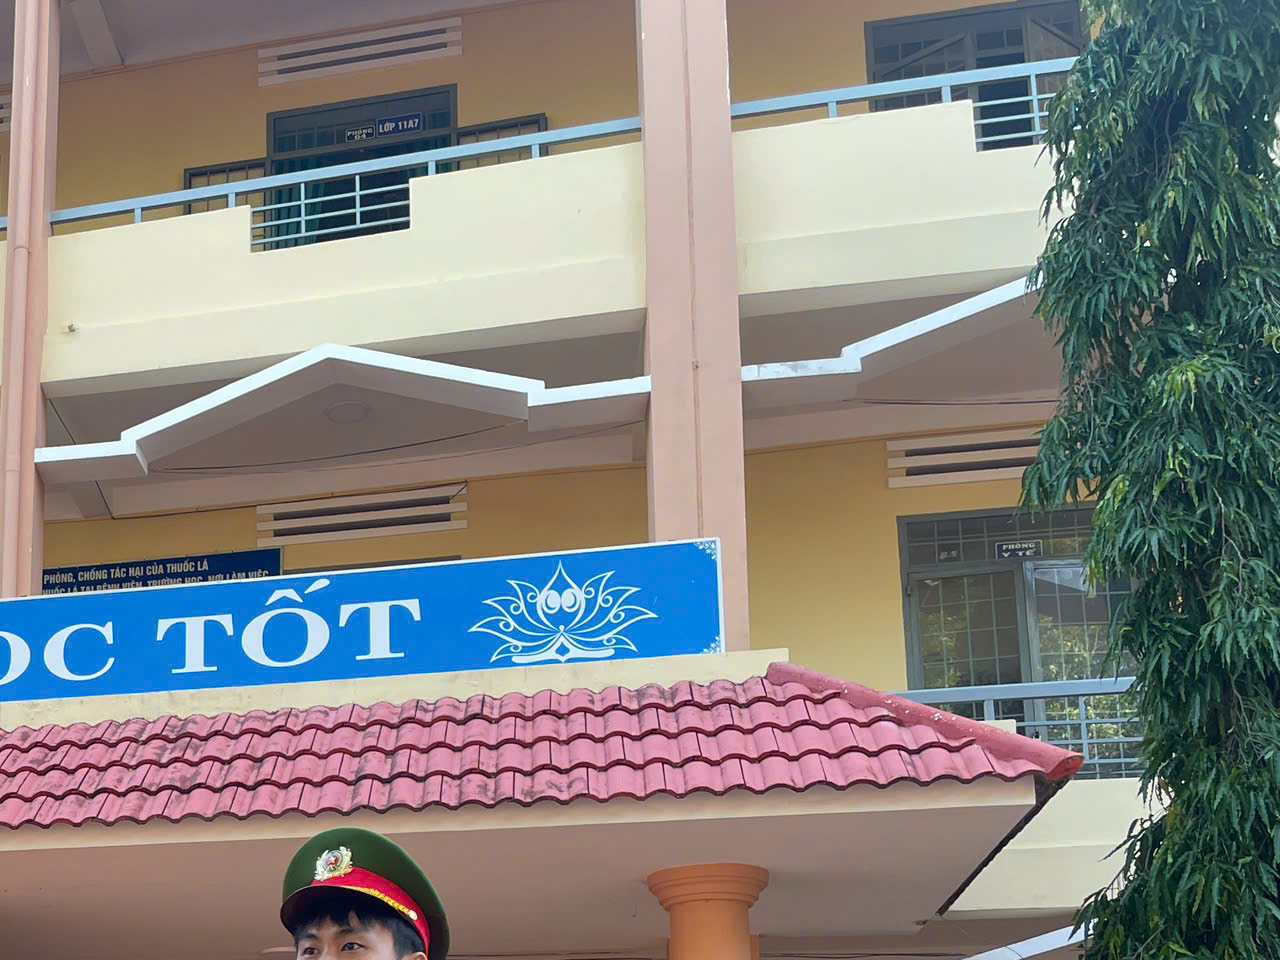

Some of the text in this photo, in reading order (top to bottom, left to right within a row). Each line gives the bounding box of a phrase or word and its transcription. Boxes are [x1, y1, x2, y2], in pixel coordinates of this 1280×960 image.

[398, 119, 419, 130] 11A7
[78, 568, 108, 582] CHỐNG
[110, 566, 126, 578] TÁC
[128, 566, 144, 578] HẠI
[146, 562, 164, 575] CỦA
[166, 559, 195, 573] THUỐC
[197, 558, 208, 571] LÁ
[156, 578, 422, 675] TỐT
